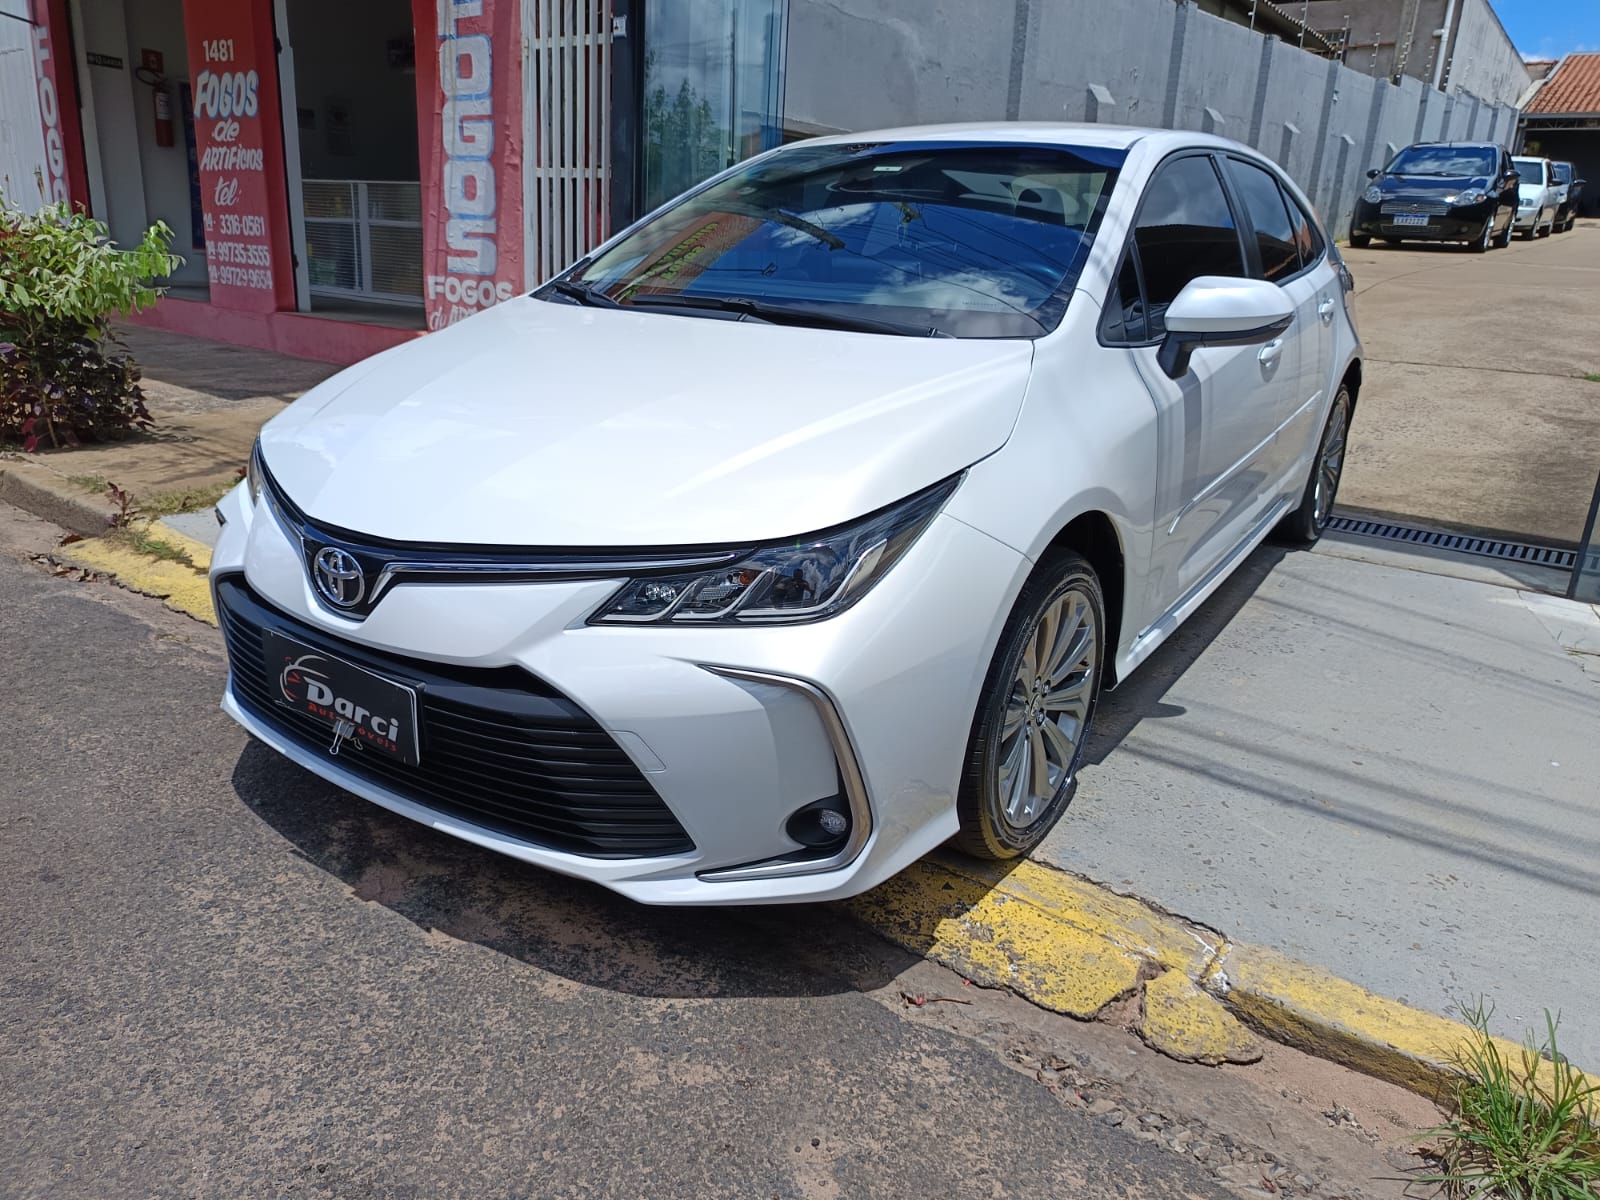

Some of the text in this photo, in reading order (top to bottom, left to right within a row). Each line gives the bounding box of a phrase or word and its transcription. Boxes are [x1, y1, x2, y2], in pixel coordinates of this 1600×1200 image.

[202, 38, 234, 62] 1481
[193, 68, 259, 118] FOGOS
[211, 117, 240, 142] de
[427, 275, 513, 307] FOGOS
[303, 676, 399, 742] Darci
